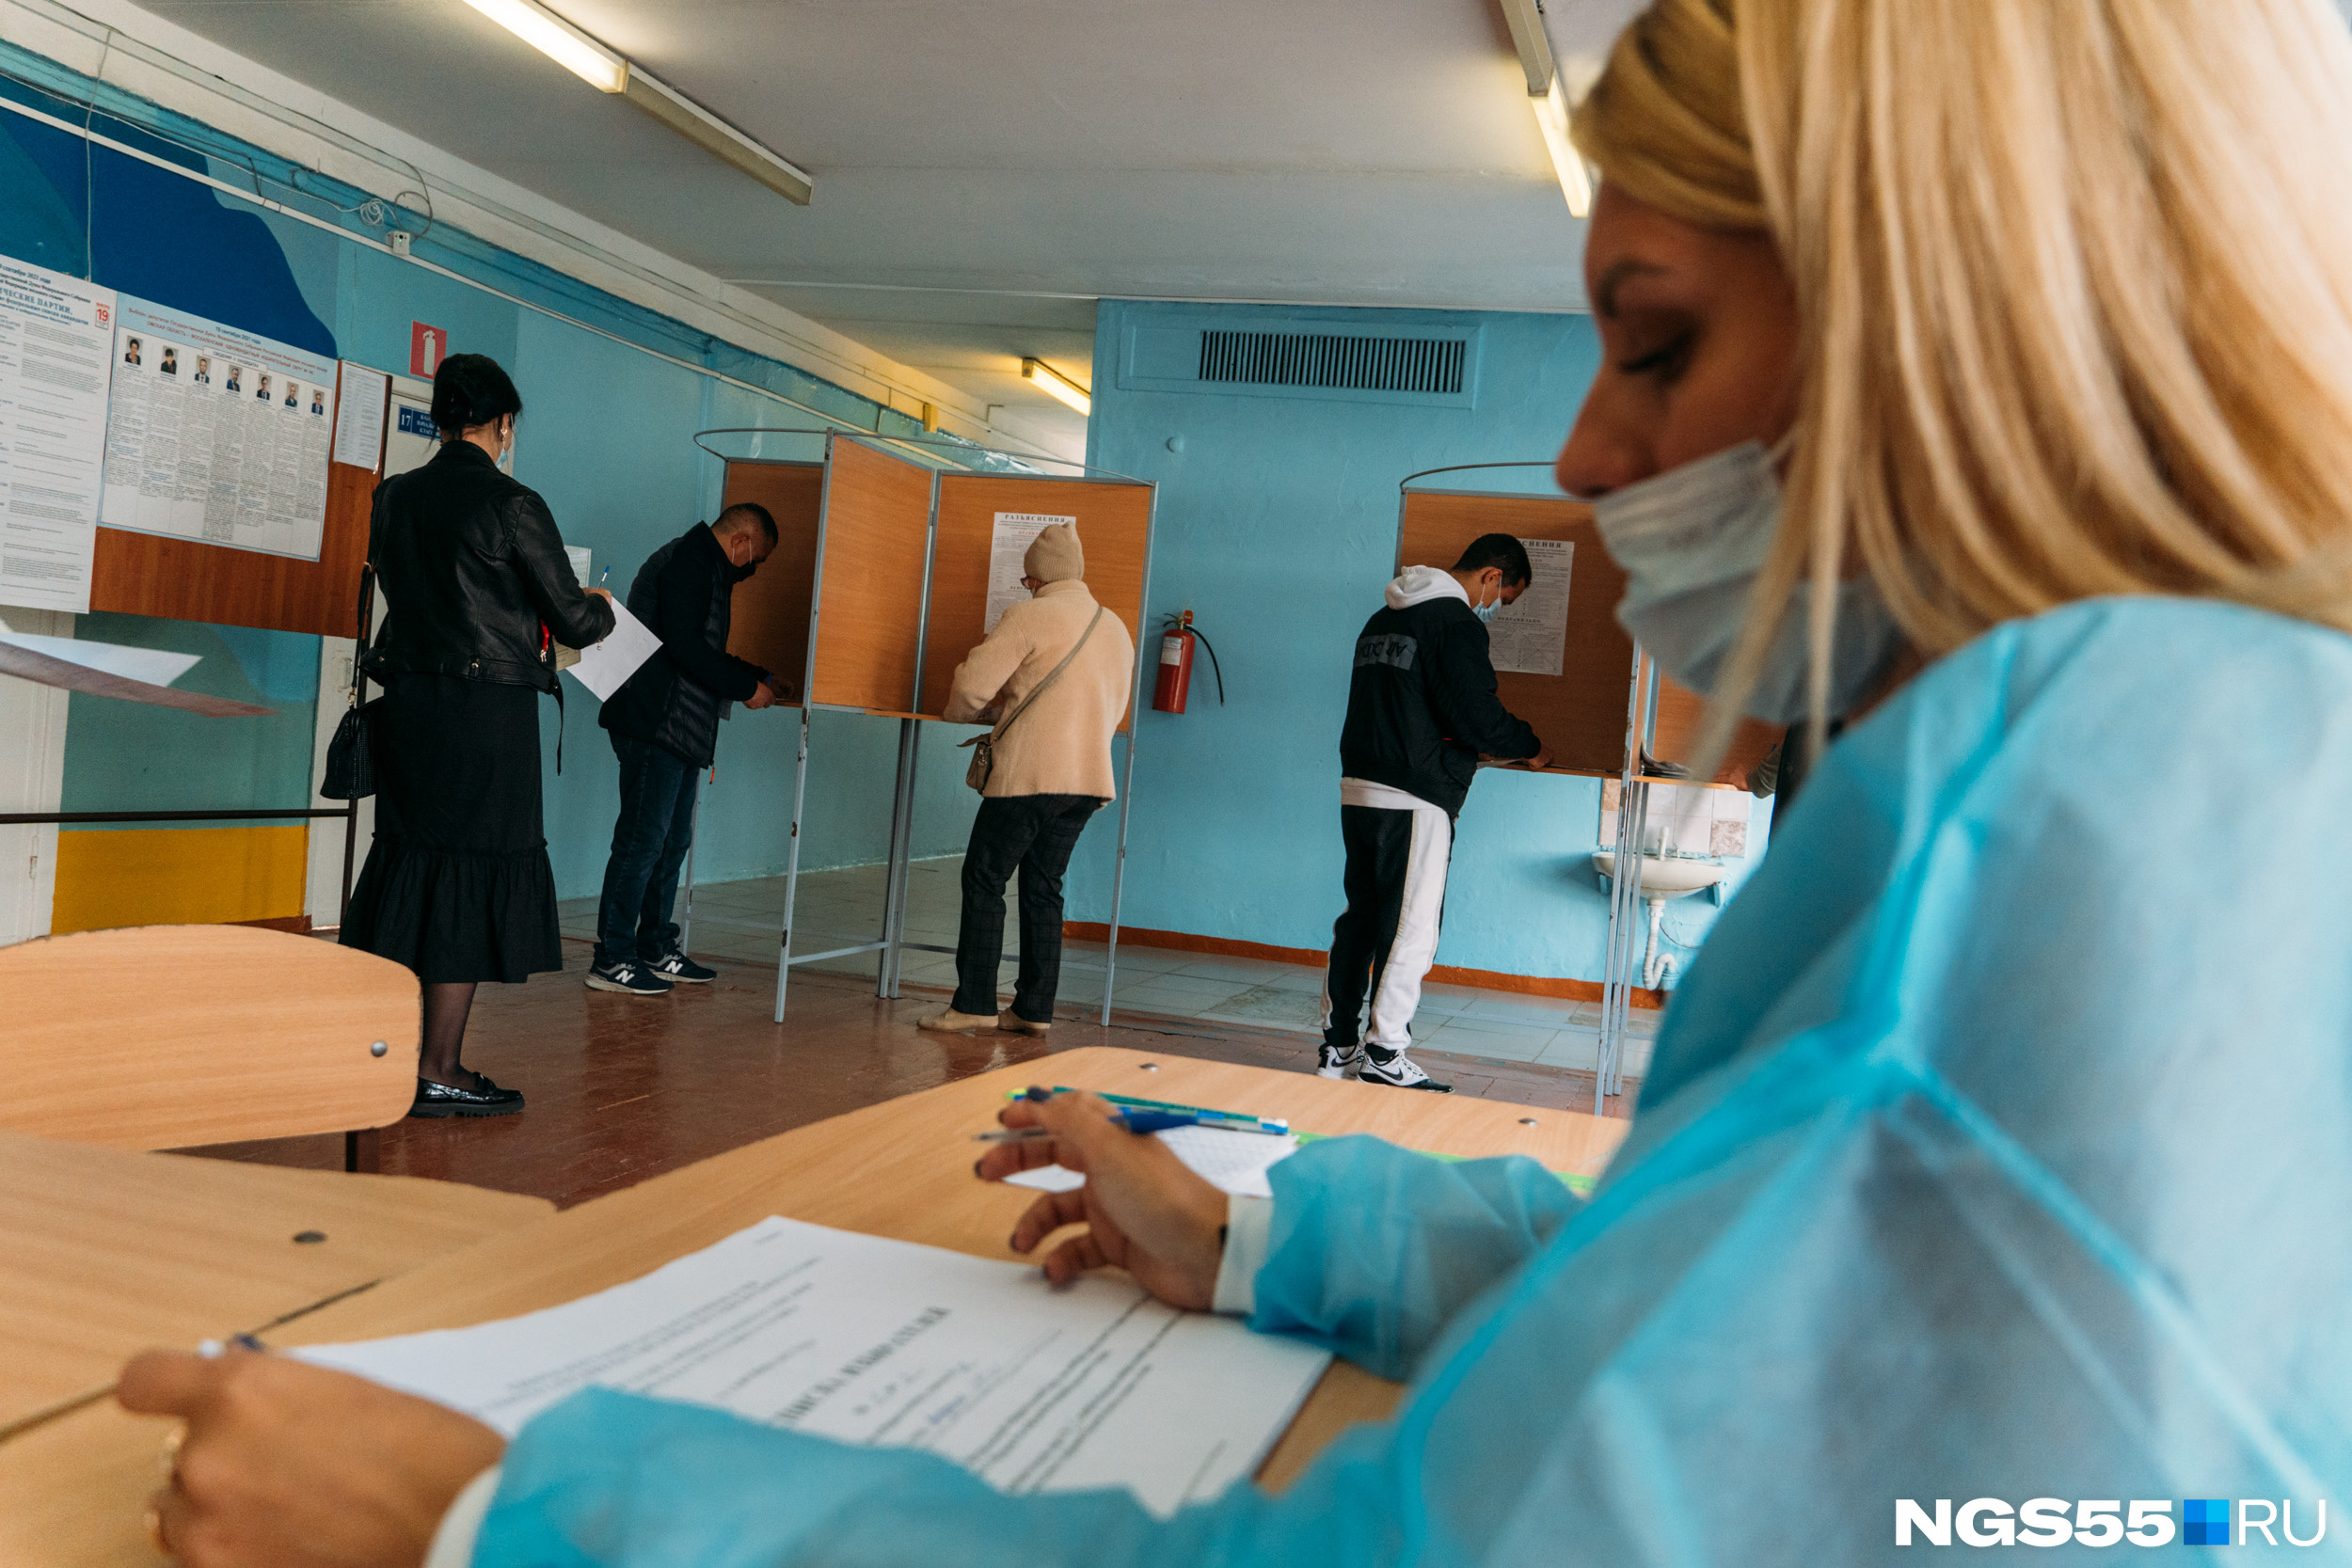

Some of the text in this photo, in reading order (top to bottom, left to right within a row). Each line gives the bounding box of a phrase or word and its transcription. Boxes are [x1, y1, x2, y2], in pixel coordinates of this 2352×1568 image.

[38, 297, 73, 315] ПАРТИИ,
[97, 309, 109, 322] 19
[401, 414, 411, 426] 17
[1005, 515, 1065, 523] РАЗЪЯСНЕНИЯ
[664, 960, 684, 974] N
[614, 970, 635, 984] N
